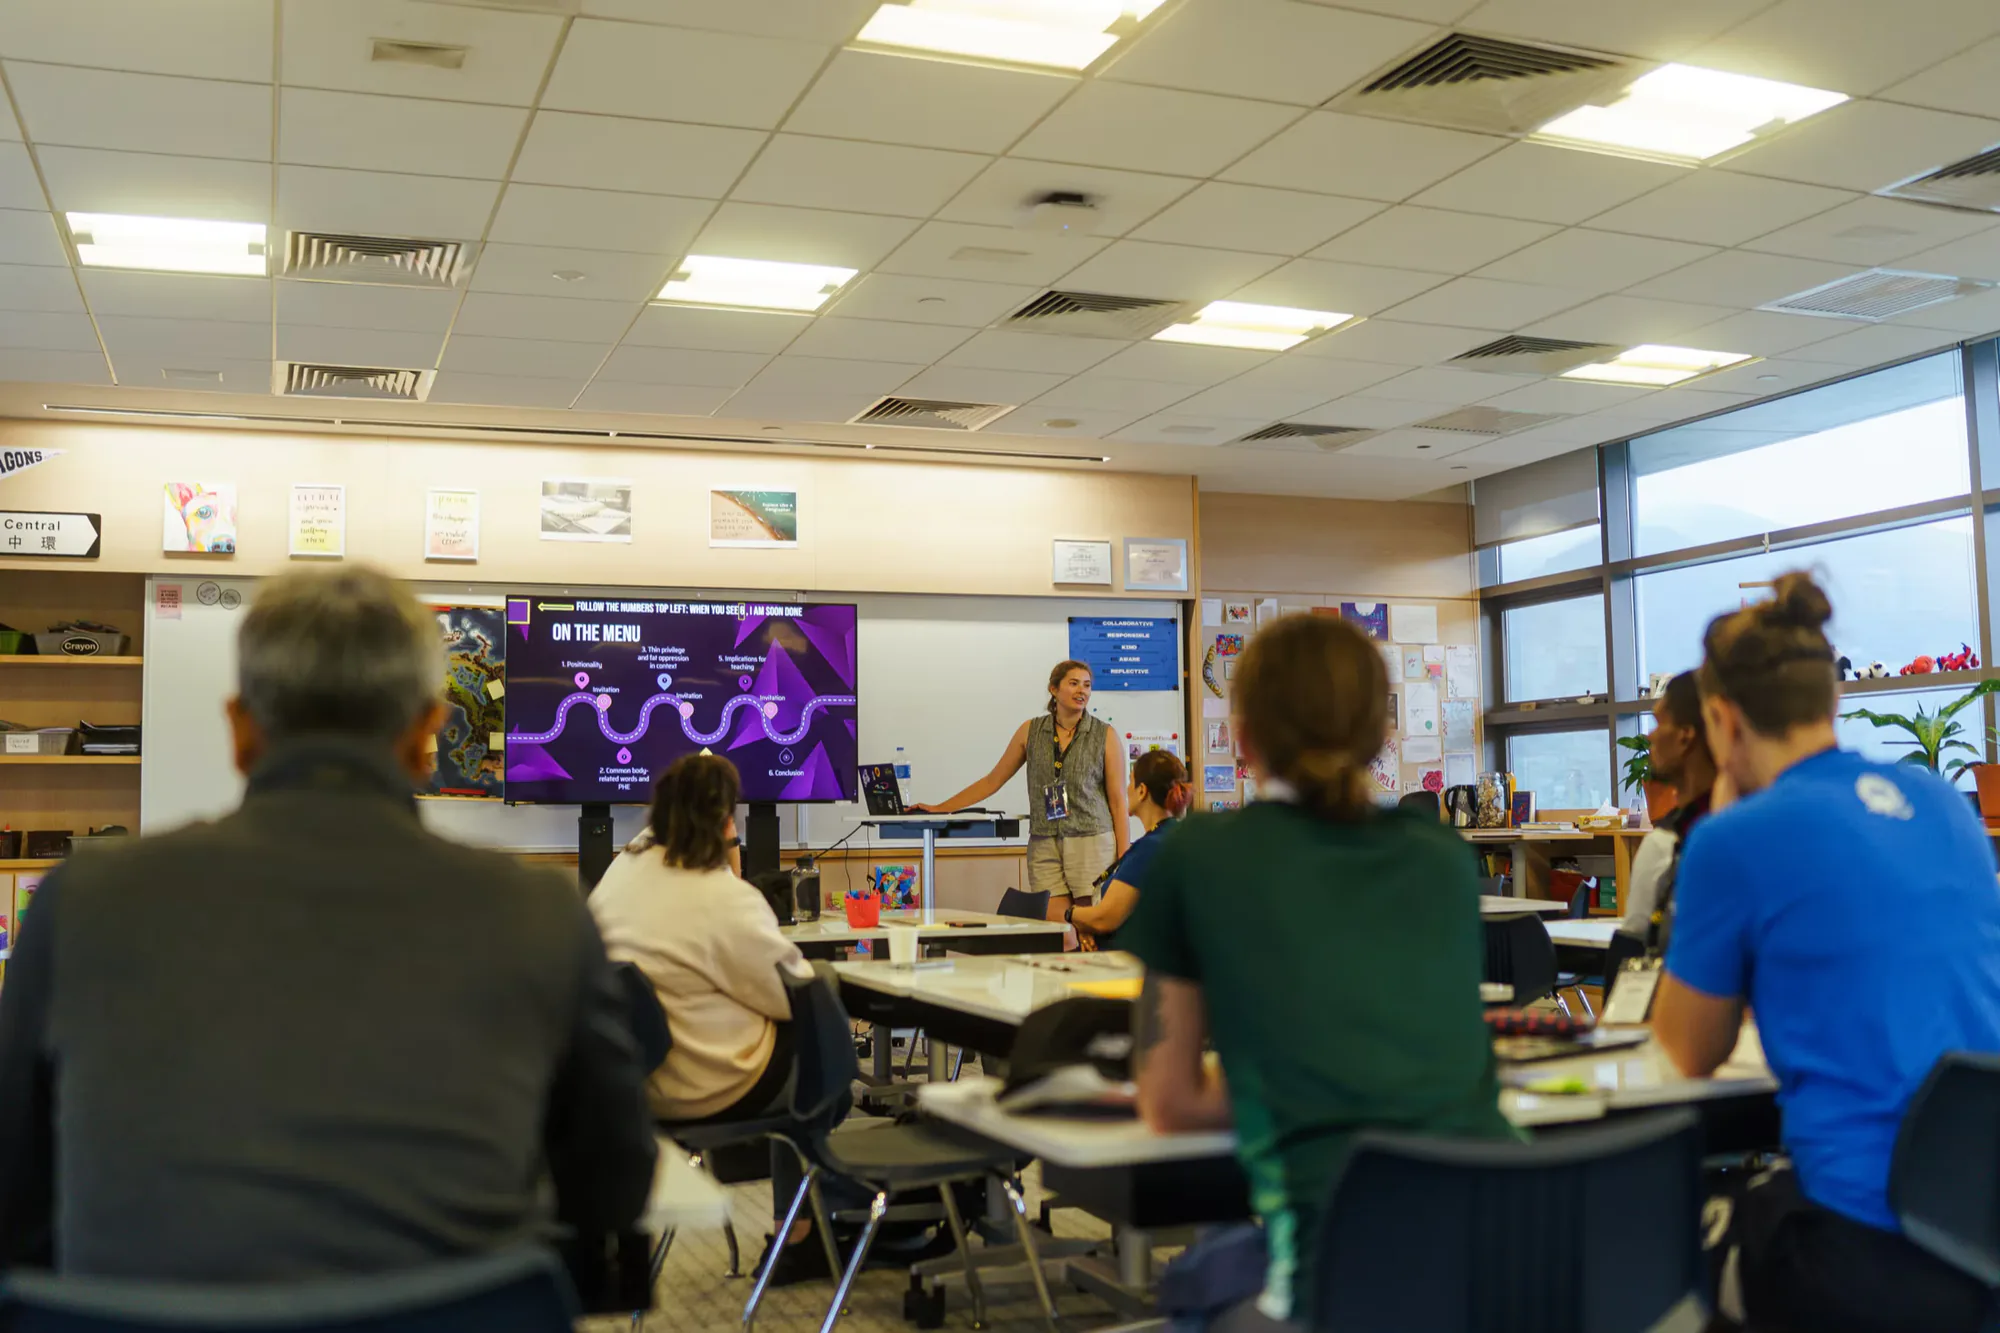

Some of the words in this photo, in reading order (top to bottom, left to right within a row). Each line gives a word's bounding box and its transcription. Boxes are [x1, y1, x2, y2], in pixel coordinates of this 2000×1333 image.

[4, 519, 60, 531] Central
[8, 535, 57, 551] 中環
[576, 601, 604, 612] FOLLOW
[605, 602, 619, 612] THE
[620, 602, 654, 613] NUMBERS
[655, 603, 669, 614] TOP
[669, 603, 689, 614] LEFT:
[690, 604, 709, 615] WHEN
[710, 604, 725, 615] YOU
[726, 605, 739, 615] SEE
[753, 606, 764, 616] AM
[765, 606, 783, 616] SOON
[785, 606, 803, 617] DONE
[552, 623, 571, 641] ON
[574, 624, 600, 642] THE
[603, 625, 641, 642] MENU
[64, 642, 96, 651] Crayon
[725, 655, 758, 663] Implications
[566, 661, 602, 669] Positionality
[730, 663, 755, 671] teaching
[620, 775, 638, 783] words
